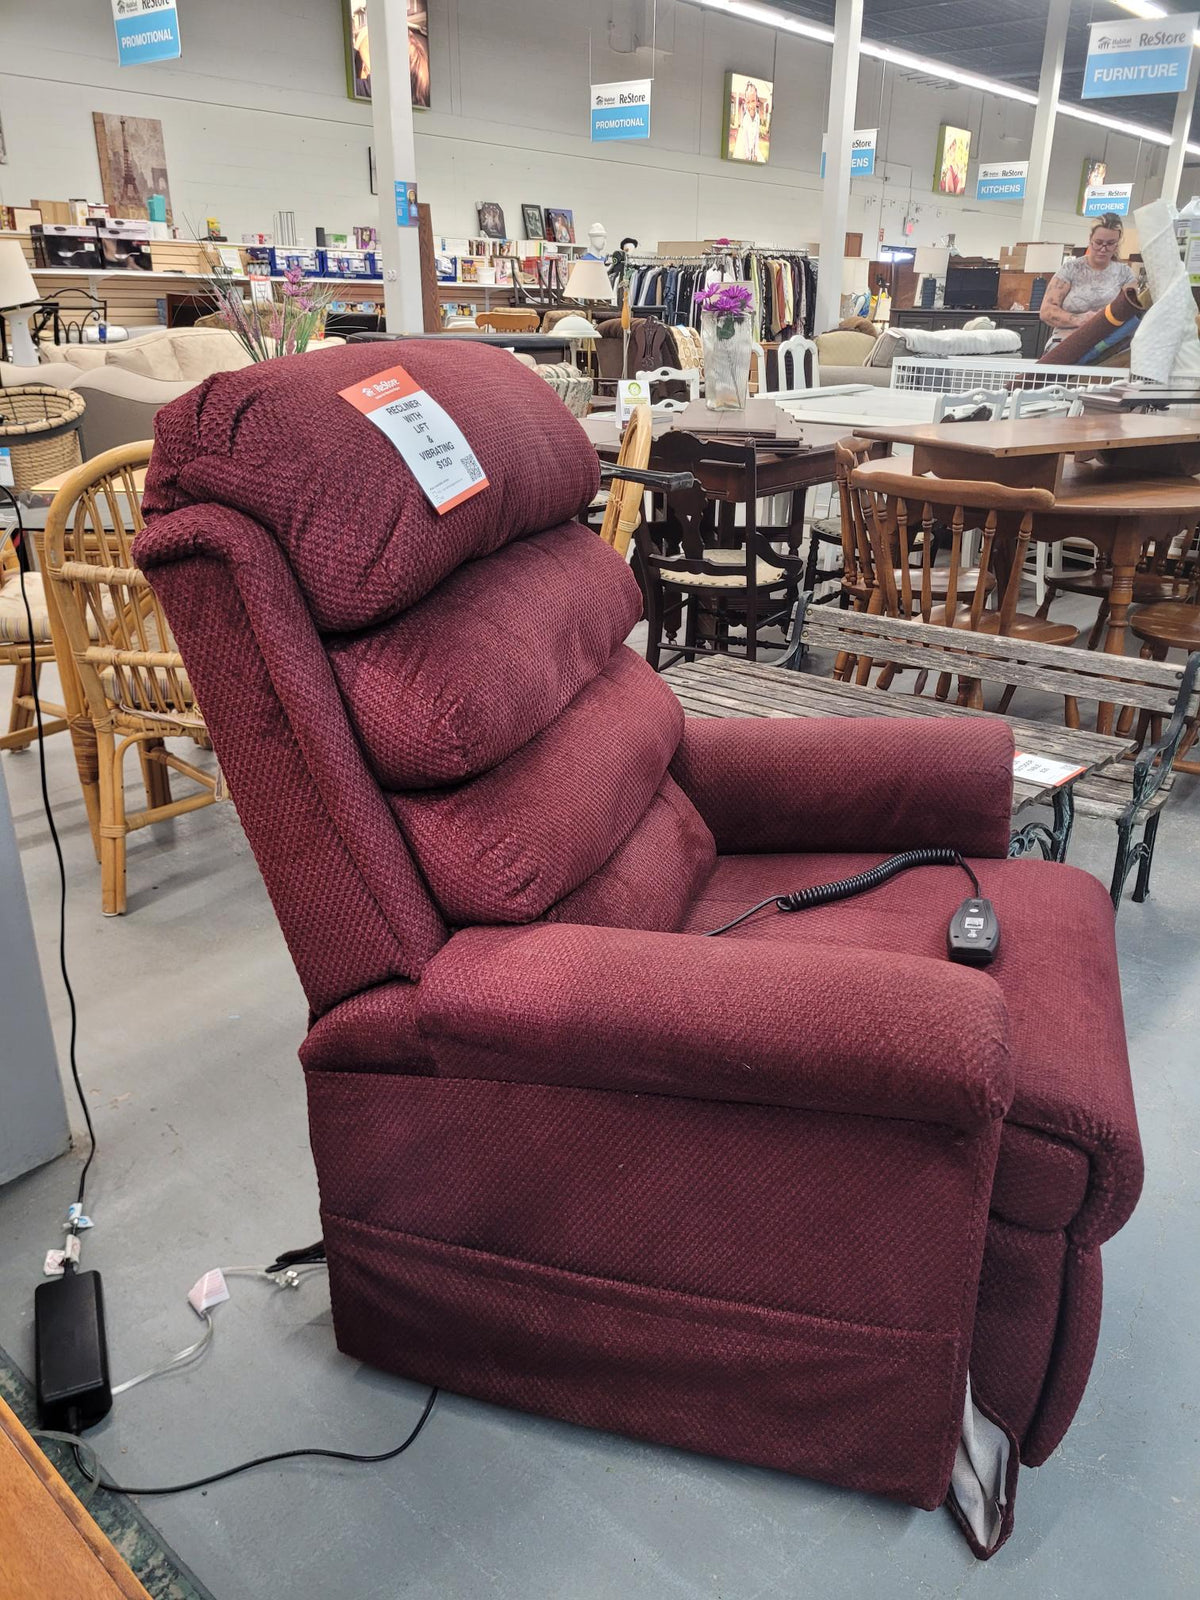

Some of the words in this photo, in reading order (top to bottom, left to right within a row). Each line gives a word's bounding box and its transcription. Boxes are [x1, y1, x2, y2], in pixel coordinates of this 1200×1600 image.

[121, 28, 174, 48] PROMOTIONAL
[1139, 31, 1187, 47] ReStore
[1094, 62, 1179, 83] FURNITURE
[619, 93, 646, 104] ReStore
[595, 118, 645, 129] PROMOTIONAL
[852, 139, 872, 149] eStore
[1001, 169, 1024, 177] ReStore
[980, 184, 1021, 194] KITCHENS
[1088, 202, 1125, 211] KITCHENS
[373, 378, 400, 393] ReStore
[386, 399, 423, 416] RECLINER
[402, 411, 424, 424] WITH
[413, 422, 430, 434] LIFT
[426, 434, 434, 444] &
[419, 441, 455, 461] VIBRATING
[436, 456, 453, 470] $130
